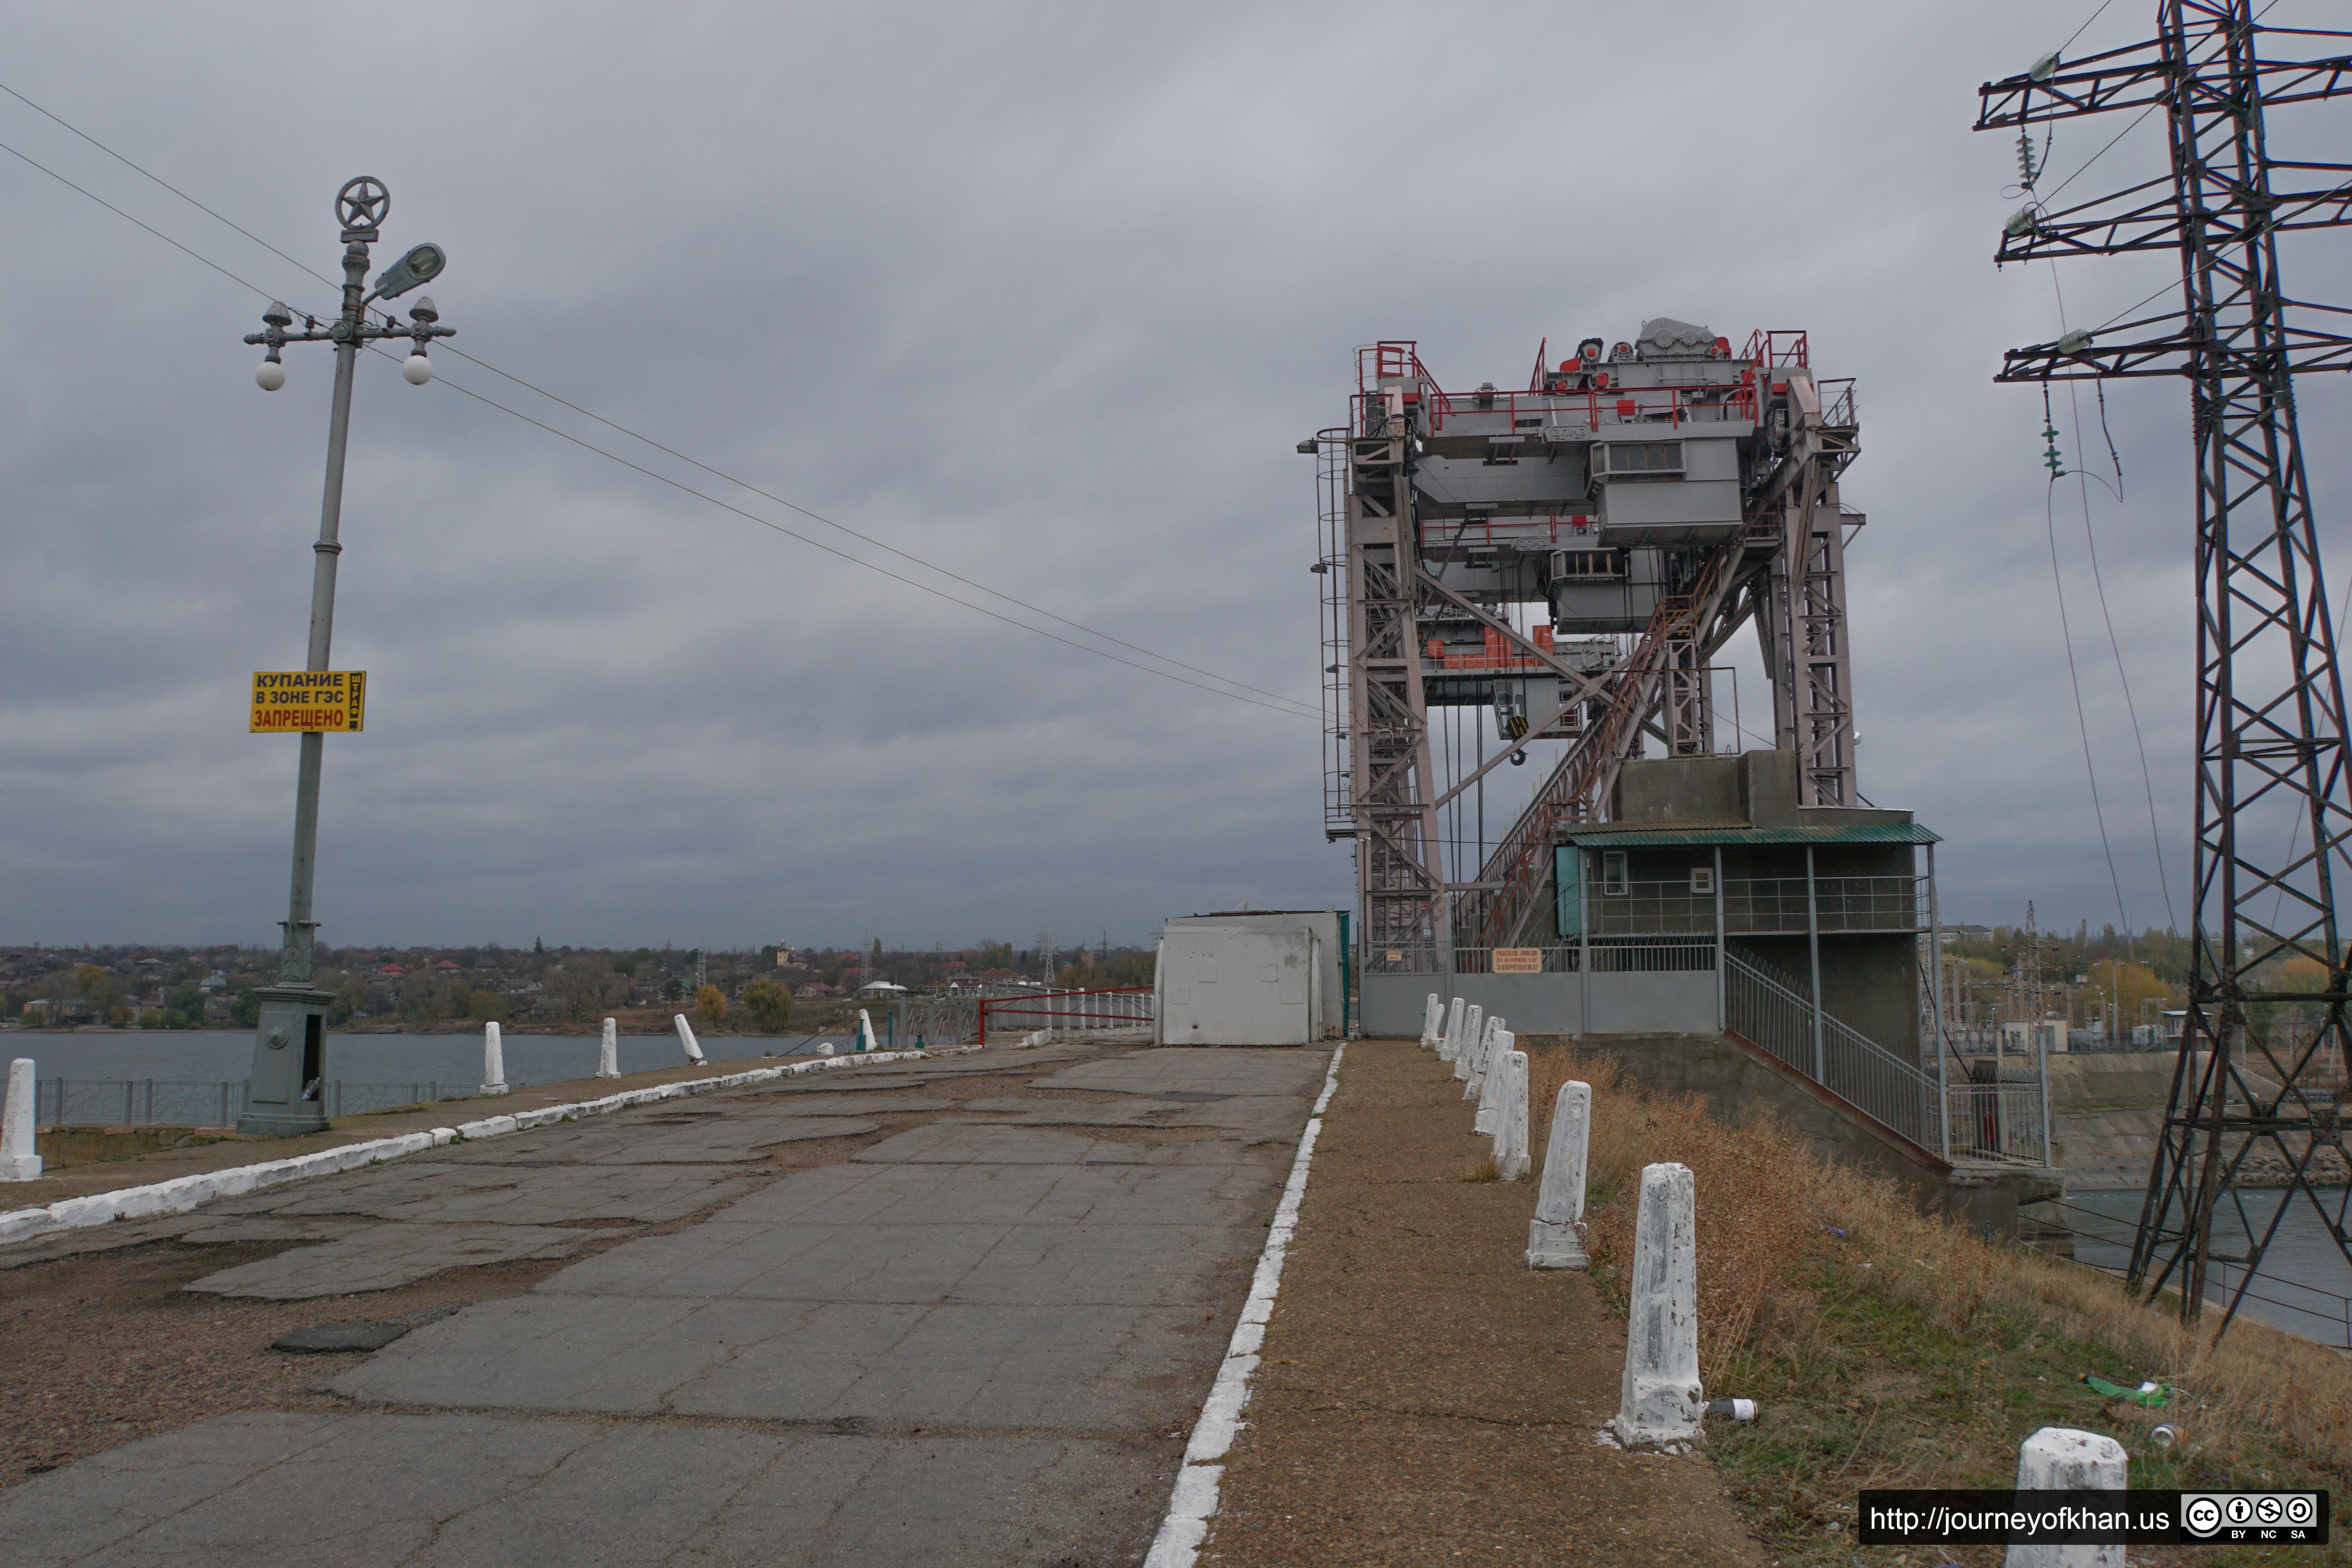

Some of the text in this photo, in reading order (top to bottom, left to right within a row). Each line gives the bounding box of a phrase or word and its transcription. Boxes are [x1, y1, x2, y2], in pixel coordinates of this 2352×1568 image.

[257, 674, 344, 687] КУПАНИЕ
[256, 691, 344, 704] В ЗОНЕ ГЭС
[350, 675, 361, 715] ШТРАФ
[254, 709, 343, 729] ЗАПРЕЩЕНО
